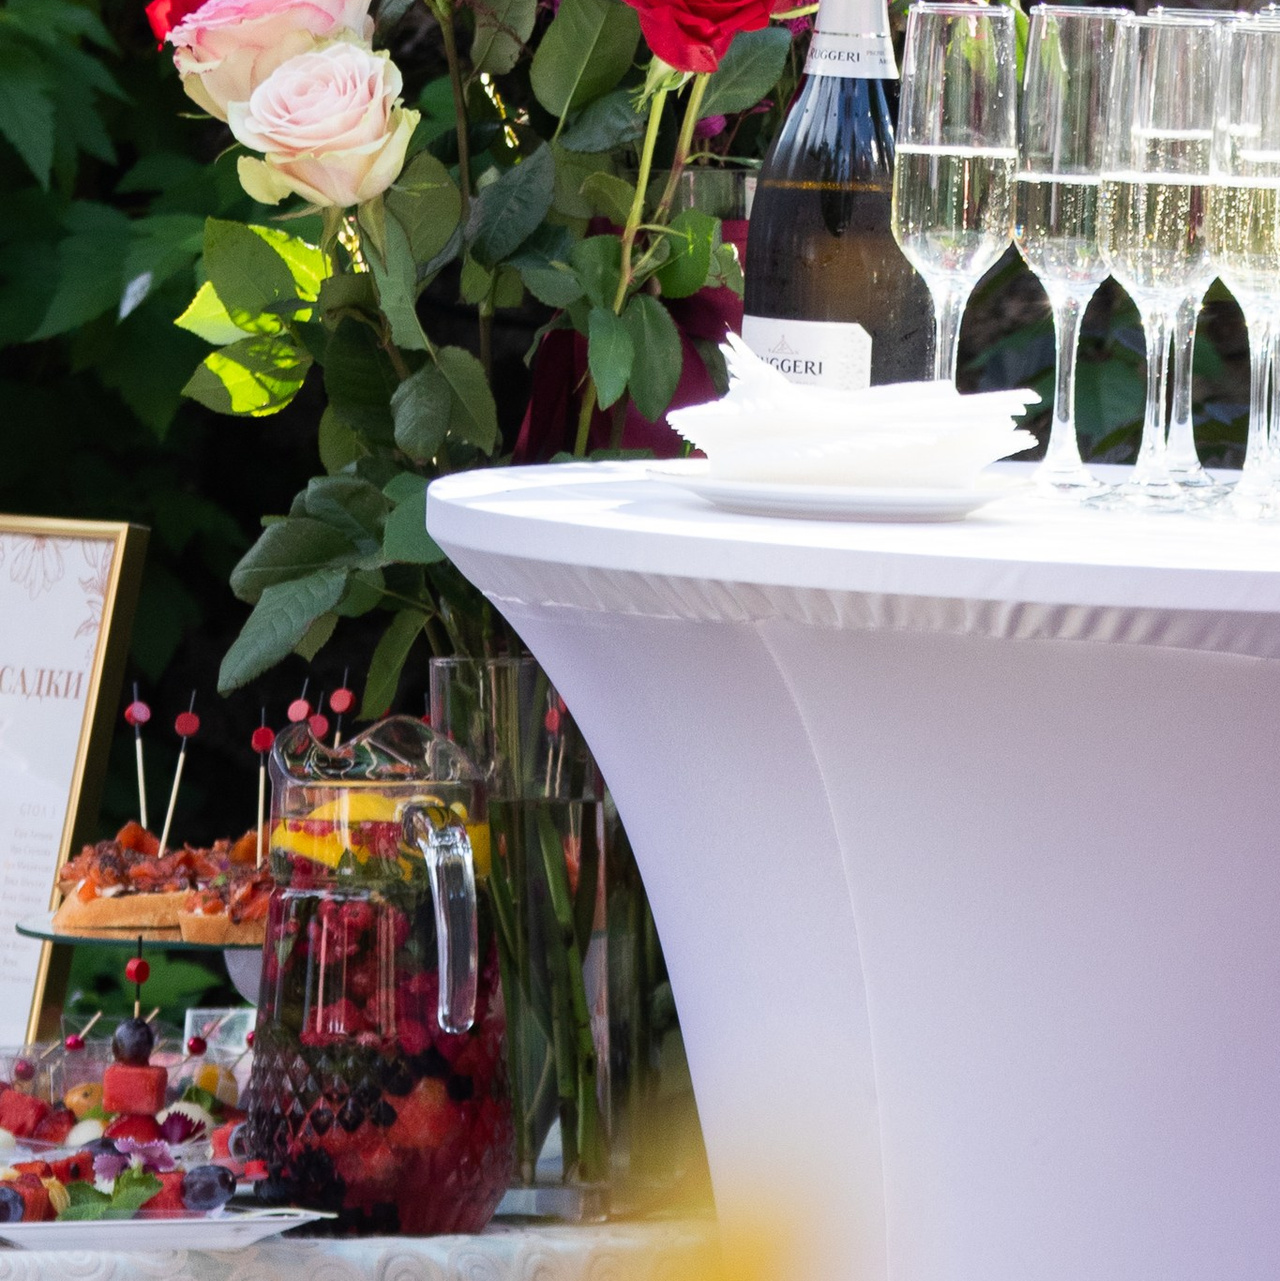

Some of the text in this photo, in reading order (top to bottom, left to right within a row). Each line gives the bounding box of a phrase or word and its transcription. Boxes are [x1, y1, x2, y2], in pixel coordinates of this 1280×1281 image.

[810, 48, 860, 63] RUGGERI
[757, 355, 823, 376] GGERI
[0, 665, 83, 701] САДКИ
